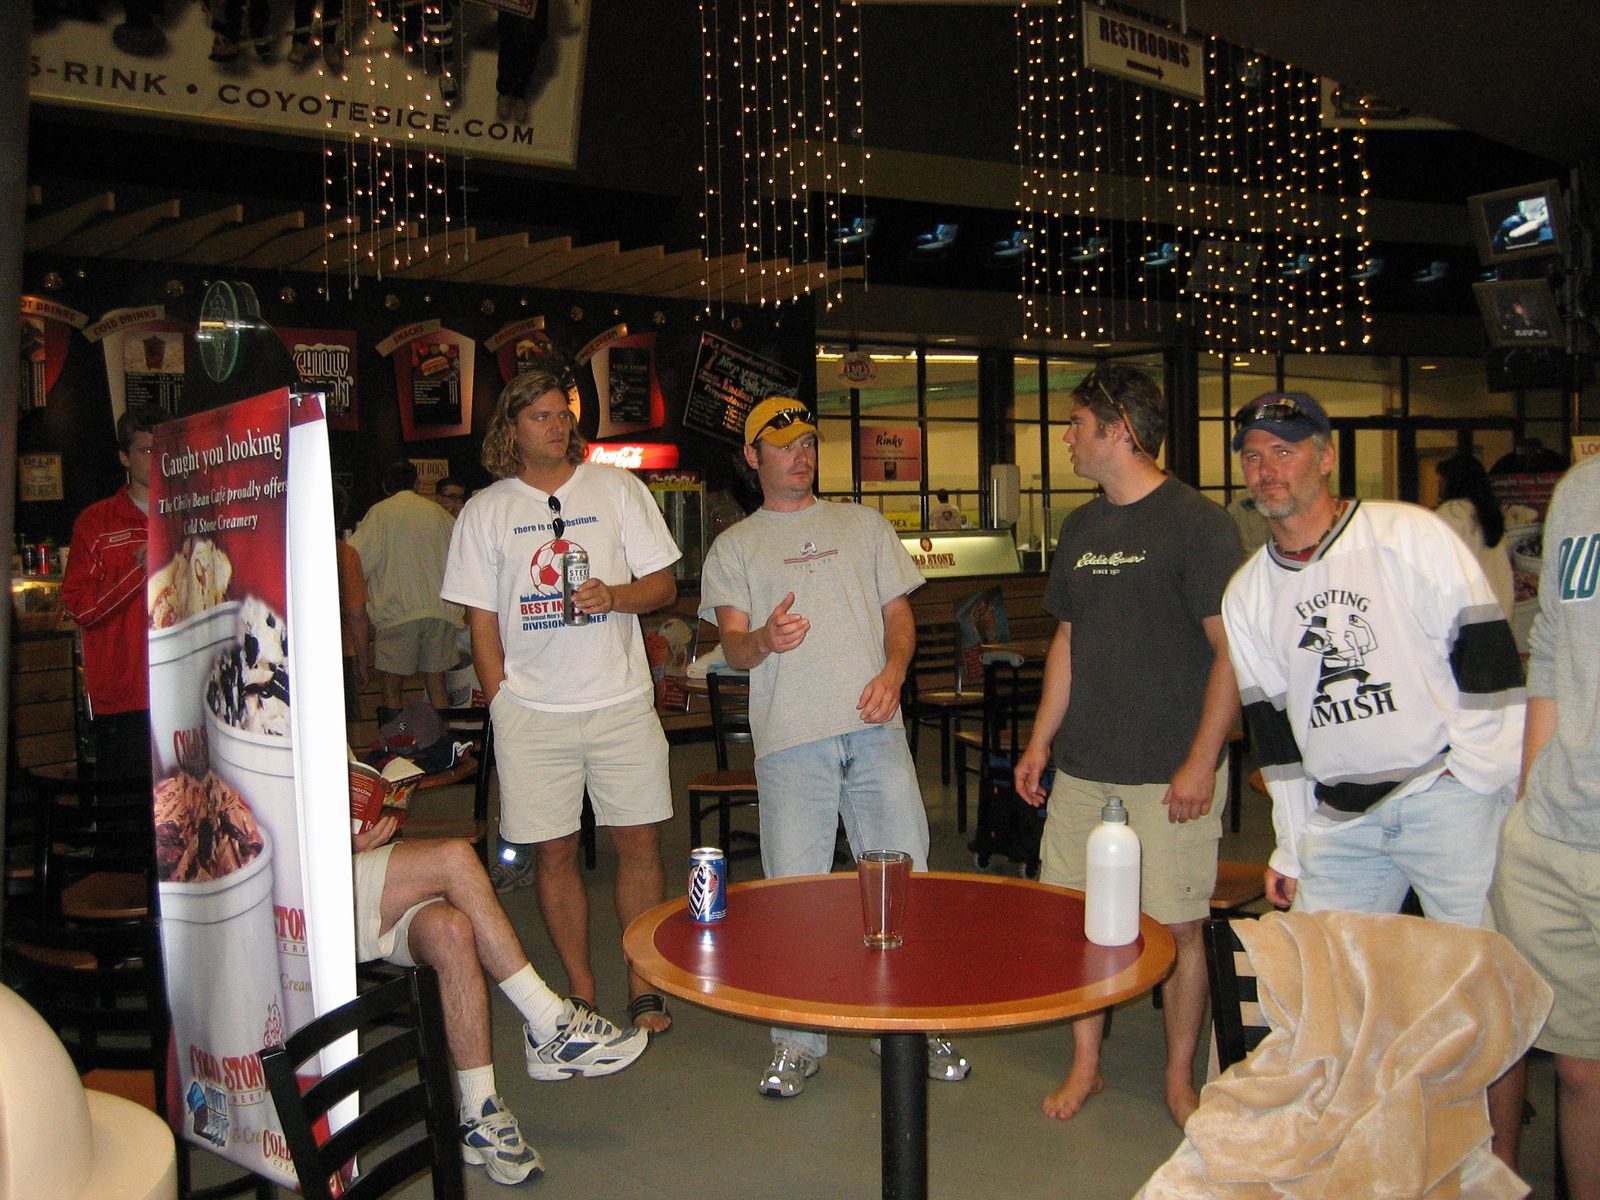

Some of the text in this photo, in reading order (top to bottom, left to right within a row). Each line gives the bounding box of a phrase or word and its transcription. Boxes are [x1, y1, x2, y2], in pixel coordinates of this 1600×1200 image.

[1099, 15, 1190, 68] RESTROOMS
[217, 83, 535, 146] COYOTESICE.COM
[118, 308, 158, 326] DRINKS
[161, 427, 283, 479] Caught you looking
[159, 498, 173, 514] The
[173, 493, 191, 512] Chilly
[192, 491, 210, 508] Bean
[210, 486, 226, 507] Café
[227, 480, 261, 505] proudly
[183, 514, 258, 536] Cold Stone Creamery
[513, 526, 537, 535] There
[537, 523, 546, 531] is
[927, 552, 956, 566] STONE
[520, 602, 549, 615] BEST
[522, 620, 566, 631] DIVISION
[222, 1051, 269, 1092] STON
